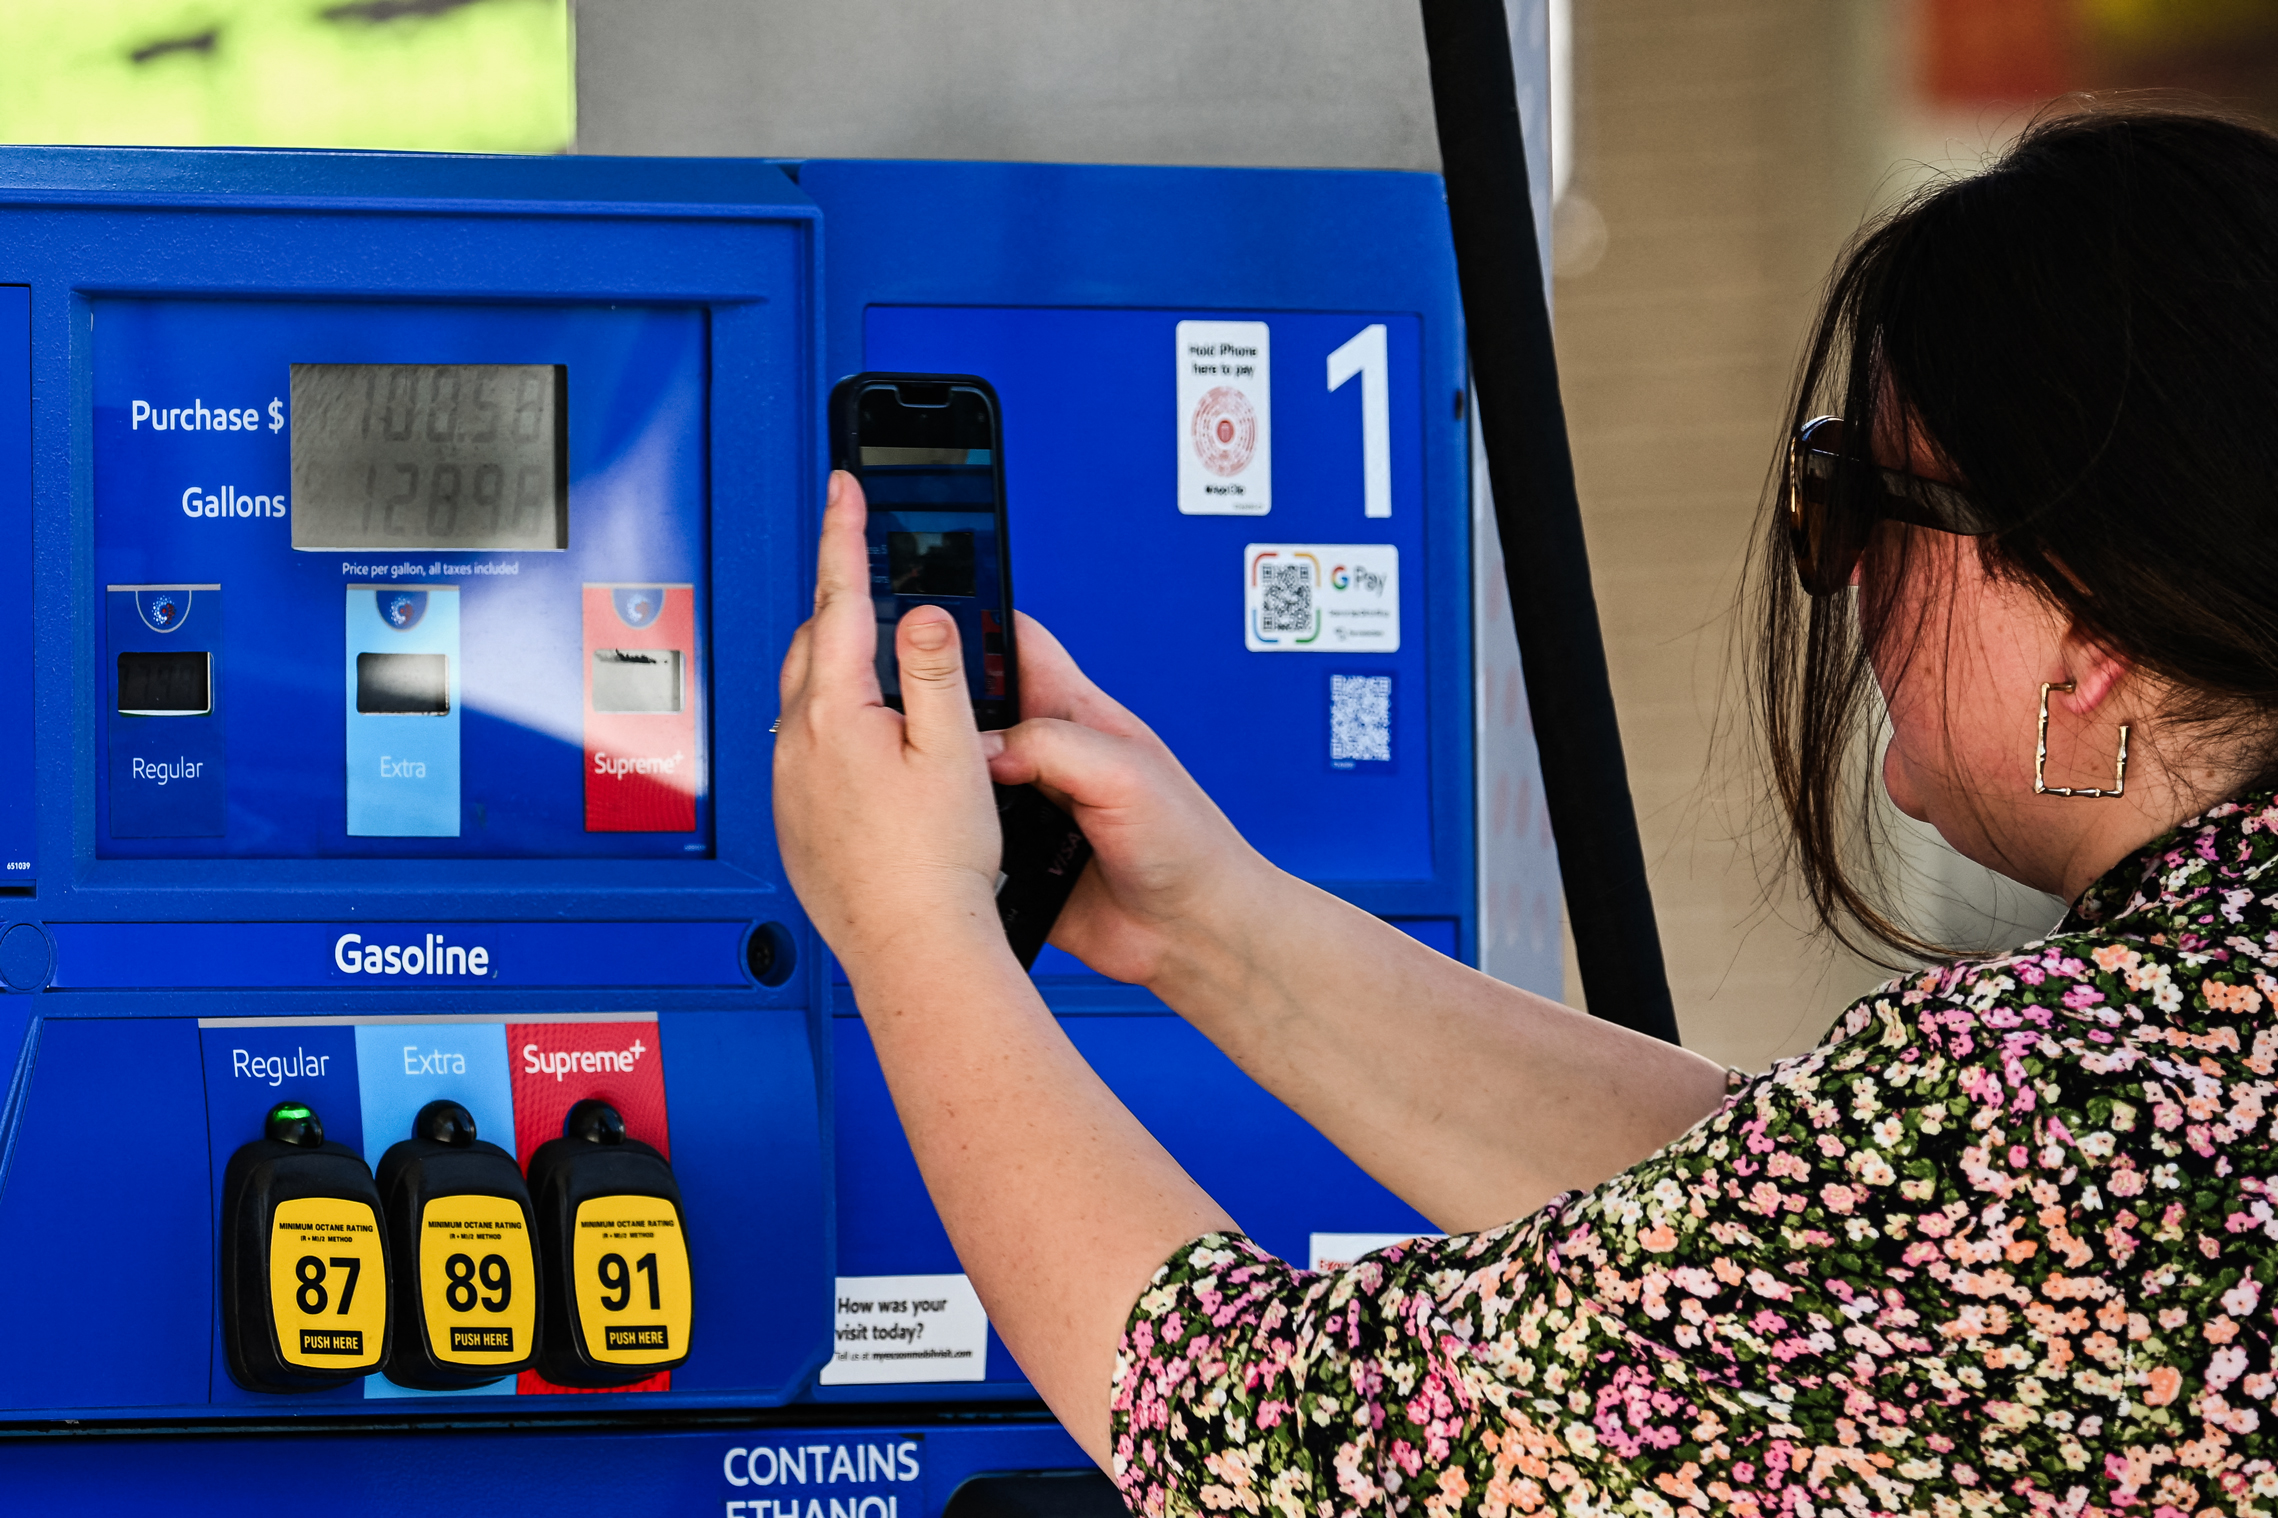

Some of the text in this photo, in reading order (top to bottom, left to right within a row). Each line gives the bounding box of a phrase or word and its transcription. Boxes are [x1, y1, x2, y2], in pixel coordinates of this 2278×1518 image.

[1189, 342, 1258, 356] Hold iPhone
[1192, 360, 1254, 378] here to pay
[132, 396, 285, 435] Purchase $
[1326, 324, 1392, 518] 1
[182, 485, 287, 518] Gallons
[342, 561, 519, 579] Price per gallon, all taxes included
[1354, 565, 1387, 598] Pay
[132, 756, 203, 785] Regular
[380, 756, 426, 778] Extra
[594, 750, 684, 780] Supreme+
[7, 861, 31, 870] 651039
[1047, 831, 1082, 876] VISA
[334, 933, 489, 976] Gasoline
[233, 1047, 330, 1087] Regular
[404, 1047, 466, 1075] Extra
[523, 1039, 646, 1082] Supreme+
[279, 1222, 374, 1233] MINIMUM OCTANE RATING
[428, 1221, 522, 1230] MINIMUM OCTANE RATING
[617, 1220, 645, 1228] OCTANE
[647, 1220, 674, 1228] RATING
[295, 1255, 361, 1315] 87
[445, 1253, 512, 1313] 89
[598, 1253, 661, 1312] 91
[837, 1297, 947, 1317] How was your
[304, 1335, 359, 1350] PUSH HERE
[454, 1333, 509, 1346] PUSH HERE
[609, 1331, 664, 1345] PUSH HERE
[835, 1322, 924, 1344] visit today?
[836, 1351, 848, 1361] Tell
[852, 1353, 859, 1361] us
[723, 1441, 920, 1487] CONTAINS
